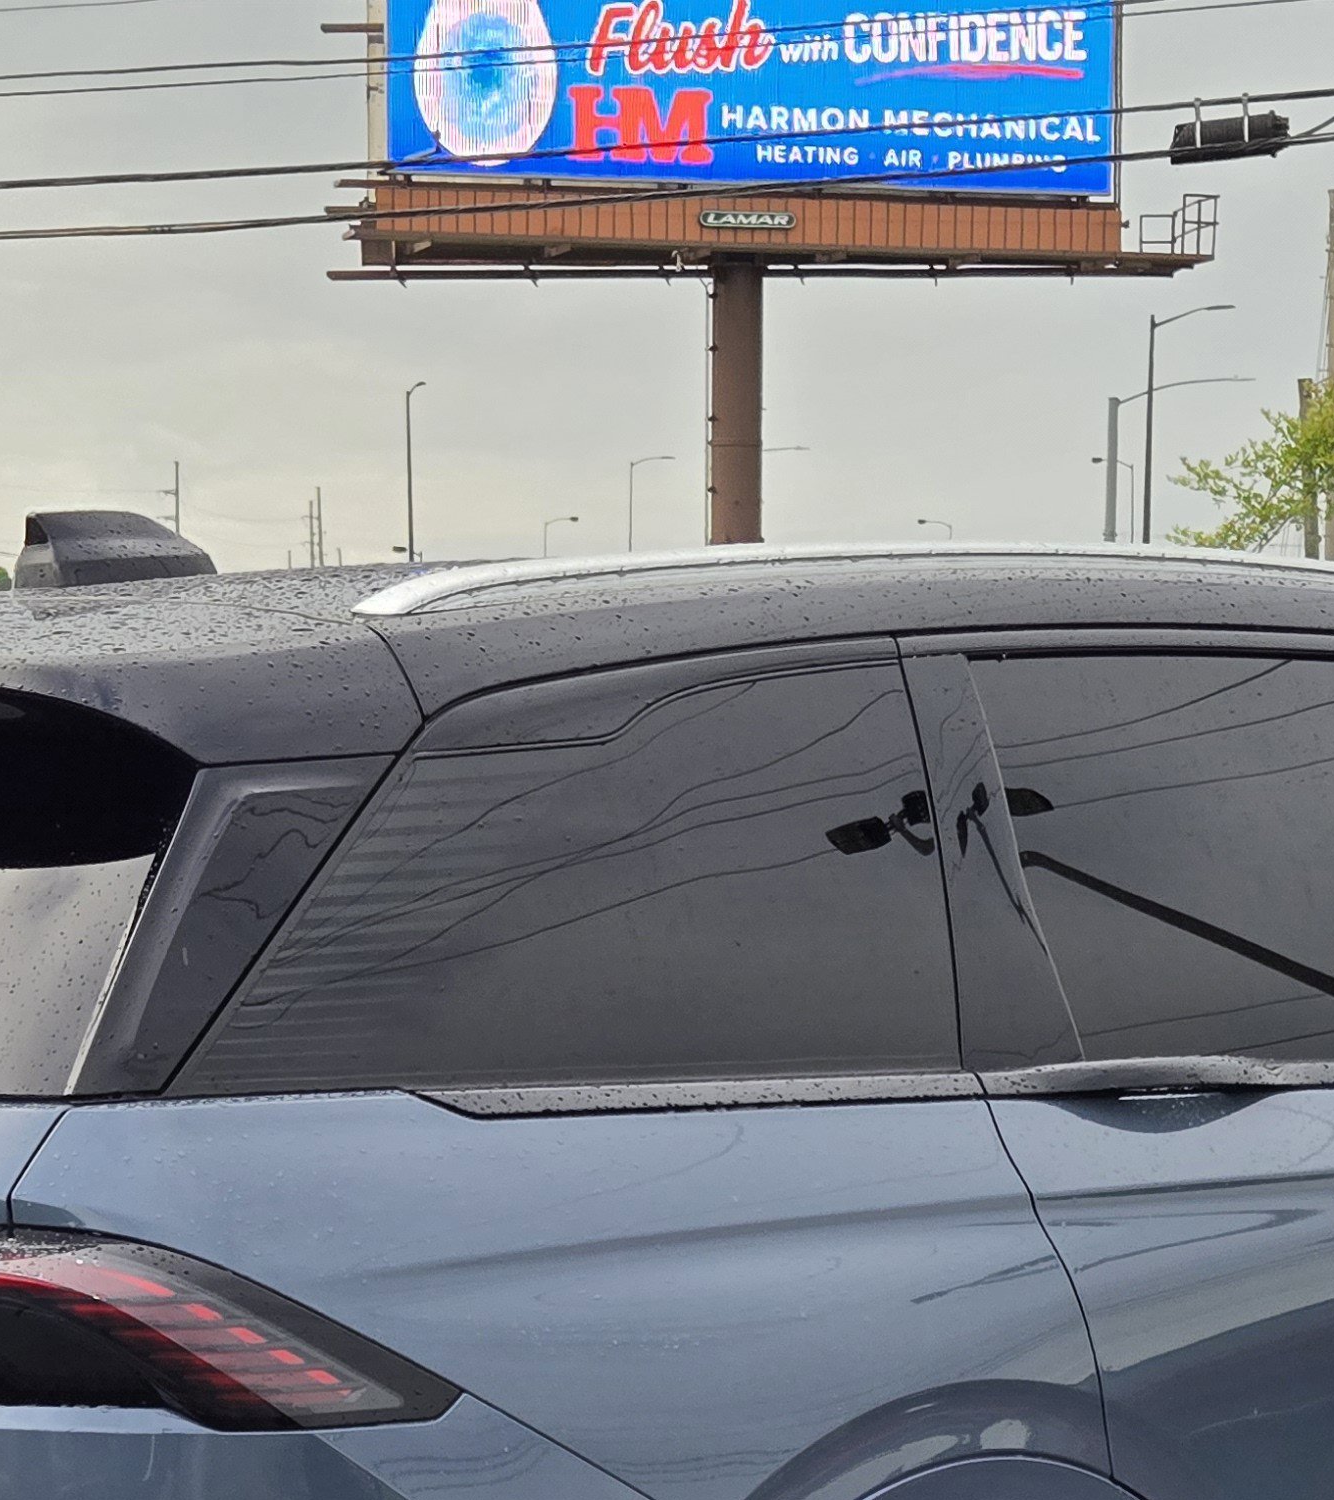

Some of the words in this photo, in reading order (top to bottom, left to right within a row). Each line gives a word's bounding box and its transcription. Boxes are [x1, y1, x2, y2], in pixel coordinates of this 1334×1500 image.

[586, 0, 775, 75] Flush
[780, 35, 838, 62] with
[844, 10, 1088, 63] CONFIDENCE
[568, 85, 714, 164] HM
[721, 104, 869, 131] HARMON
[883, 109, 1101, 142] MECHANICAL
[756, 144, 859, 165] HEATING
[884, 149, 922, 168] AIR
[706, 213, 790, 226] LAMAR
